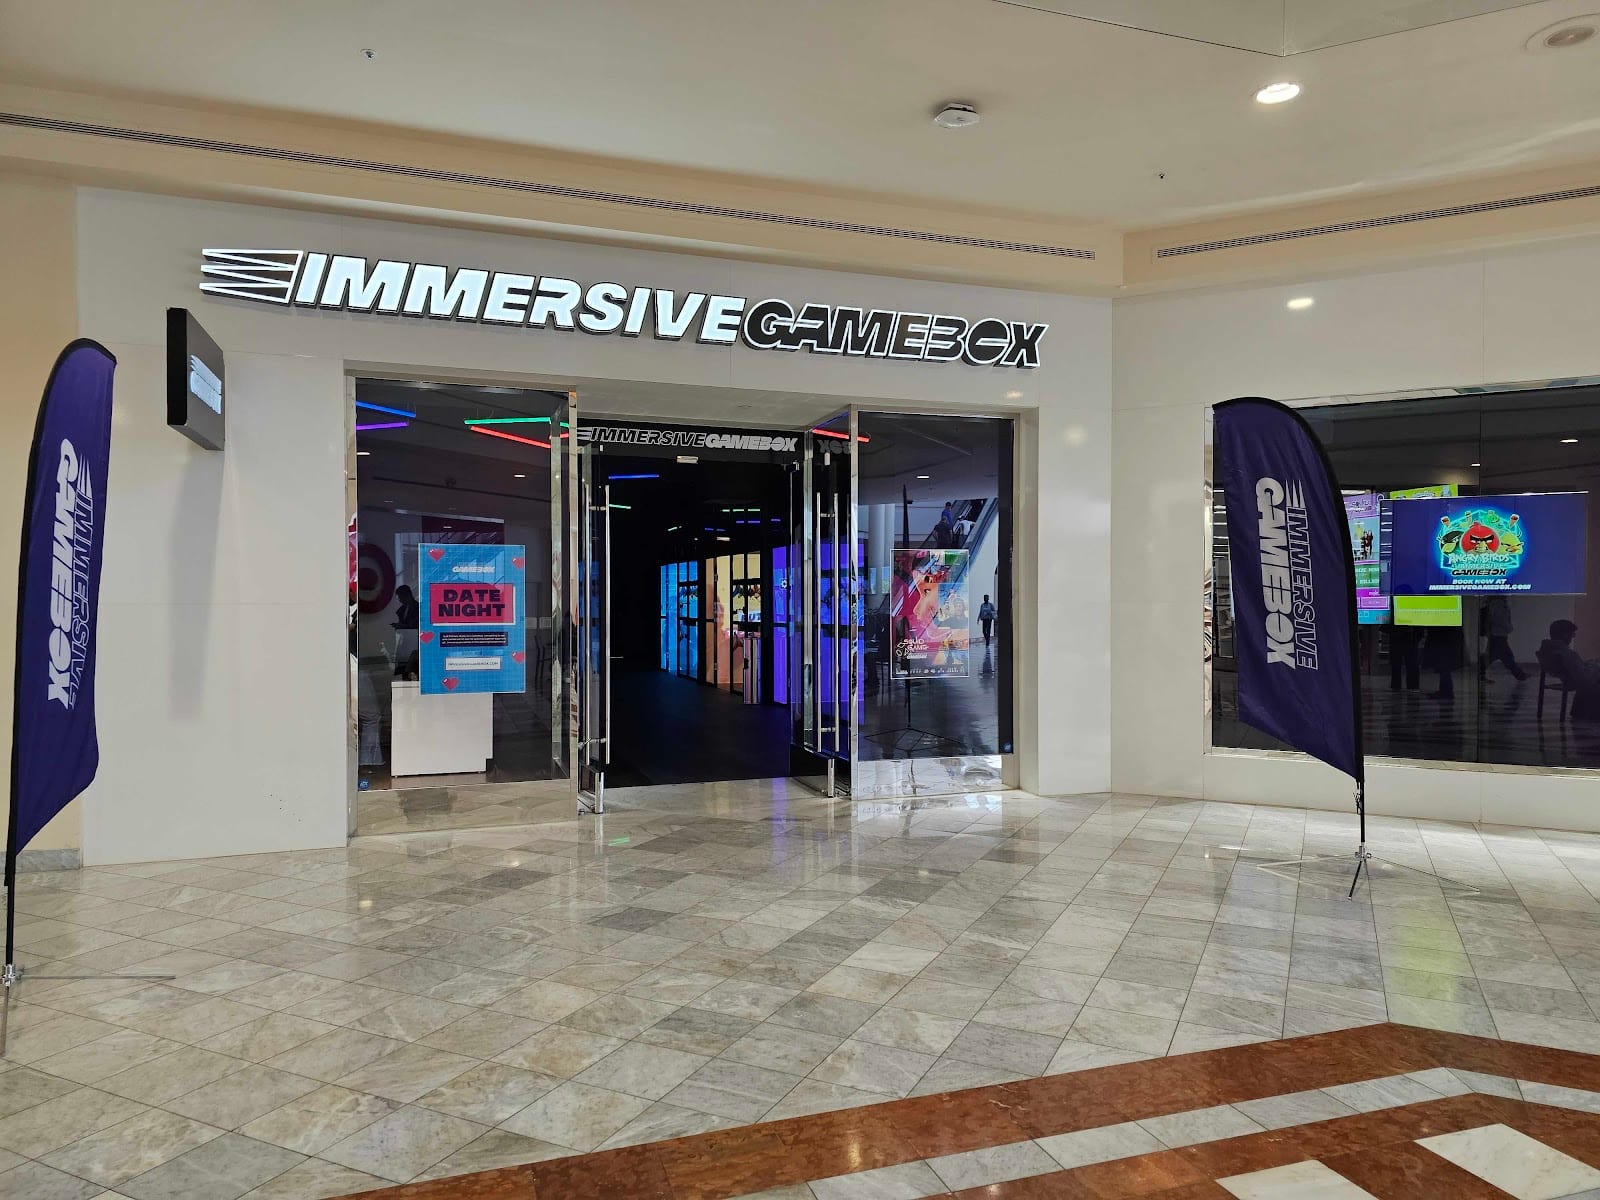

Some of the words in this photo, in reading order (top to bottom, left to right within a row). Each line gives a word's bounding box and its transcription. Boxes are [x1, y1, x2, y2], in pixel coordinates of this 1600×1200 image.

[48, 439, 78, 709] GAMEBOX
[438, 604, 505, 617] NIGHT
[443, 589, 501, 602] DATE
[1256, 477, 1296, 669] GAMEBOX
[1286, 507, 1318, 670] IMMERSIVE
